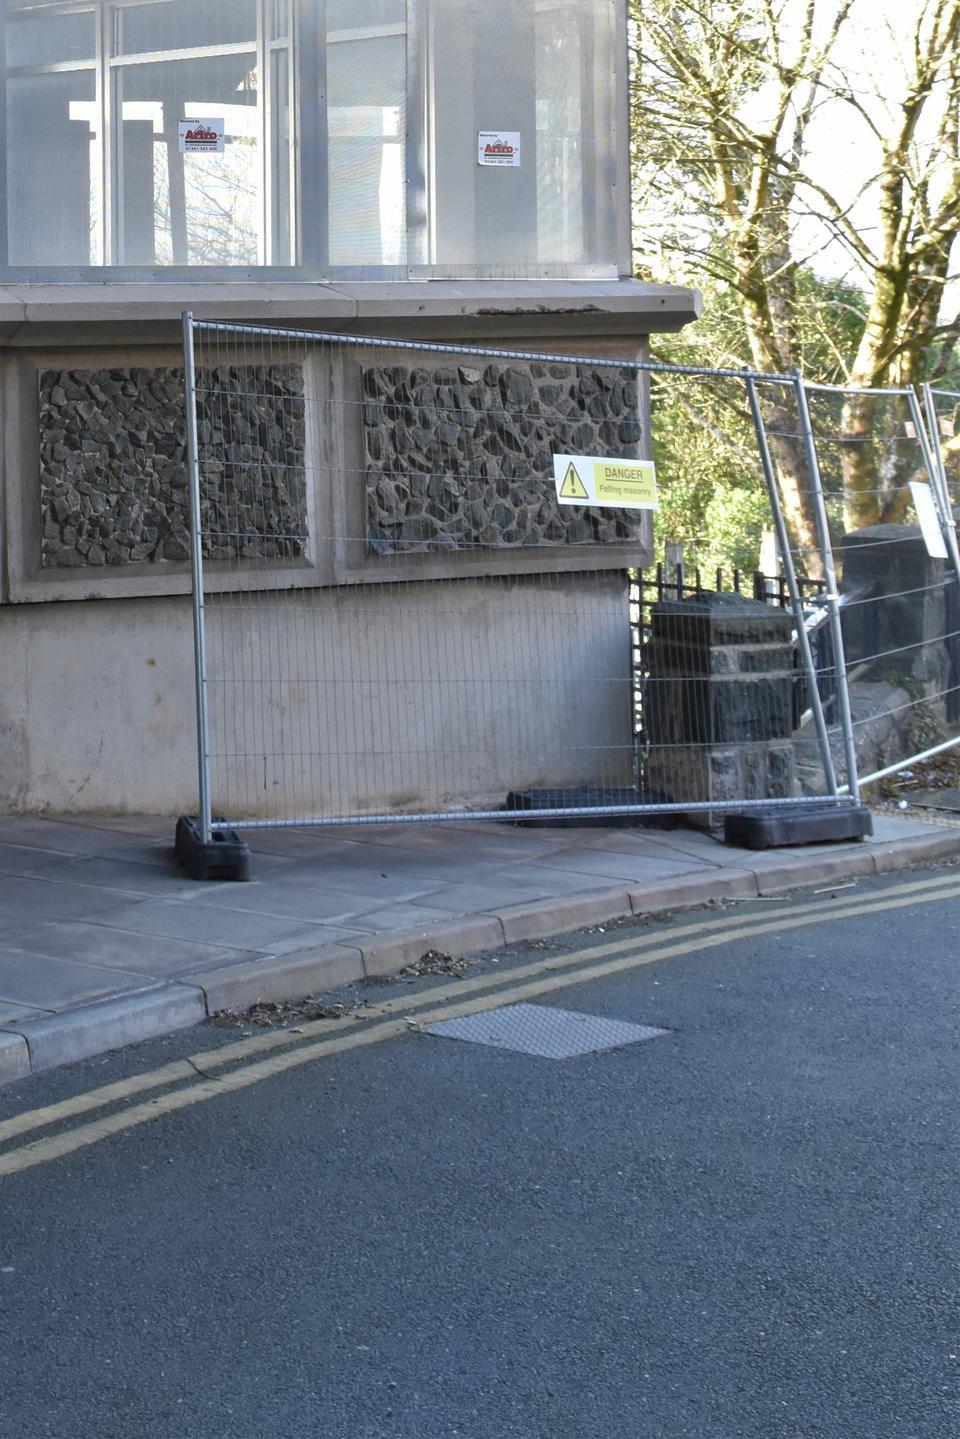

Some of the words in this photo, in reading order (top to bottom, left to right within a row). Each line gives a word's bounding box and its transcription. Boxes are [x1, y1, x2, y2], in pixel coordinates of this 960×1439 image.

[605, 467, 643, 480] DANGER
[600, 484, 622, 495] Falling
[623, 487, 651, 497] masonry
